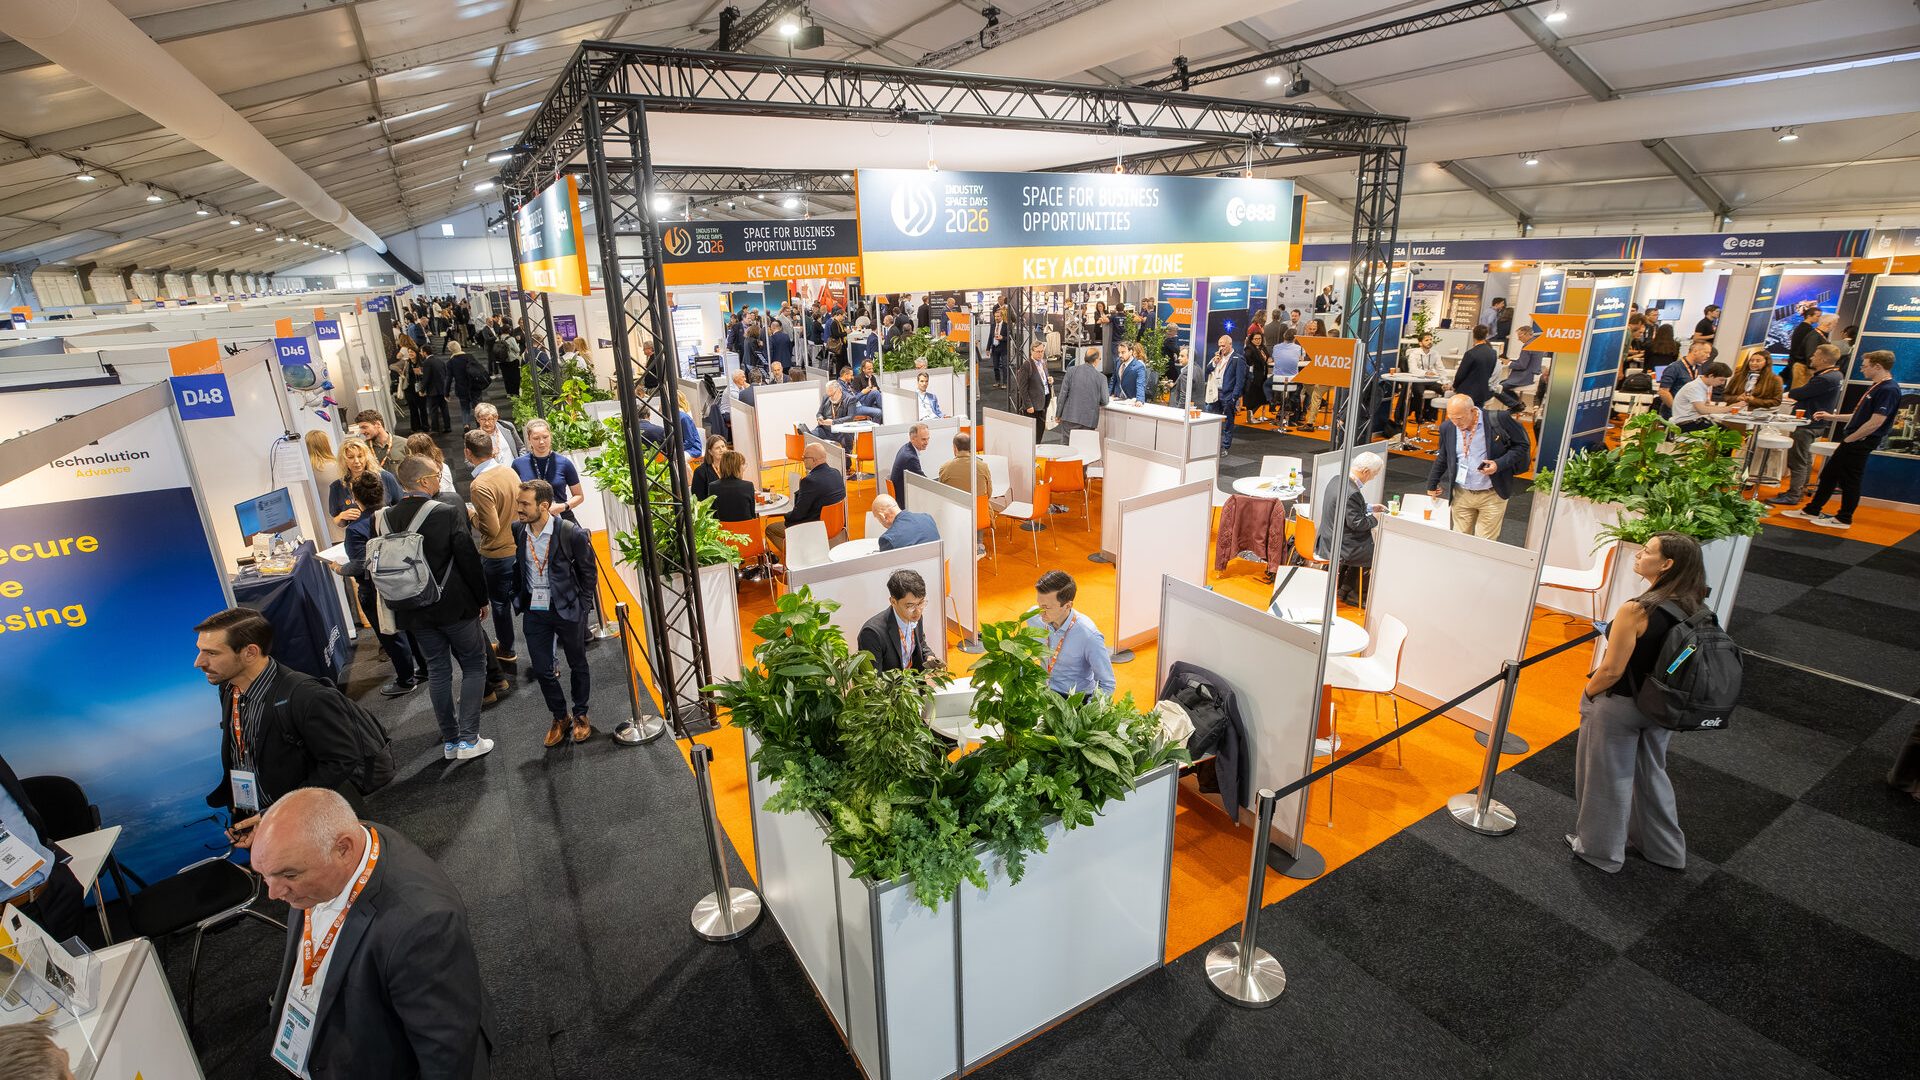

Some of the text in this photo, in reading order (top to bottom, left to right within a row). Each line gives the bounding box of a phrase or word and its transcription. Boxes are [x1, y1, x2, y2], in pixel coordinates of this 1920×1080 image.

[945, 184, 984, 195] INDUSTRY
[945, 196, 989, 207] SPACE DAYS
[1022, 186, 1160, 208] SPACE FOR BUSINESS
[945, 208, 989, 233] 2026
[1023, 212, 1131, 232] OPPORTUNITIES
[743, 225, 836, 240] SPACE FOR BUSINESS
[696, 240, 725, 254] 2026
[744, 239, 818, 253] OPPORTUNITIES
[1412, 247, 1446, 256] VILLAGE
[747, 262, 857, 279] KEY ACCOUNT ZONE
[1022, 252, 1184, 280] KEY ACCOUNT ZONE
[318, 325, 337, 335] D44
[1545, 327, 1582, 339] KAZ03
[281, 345, 306, 357] D46
[1314, 354, 1352, 370] KAZ02
[182, 387, 224, 407] D48
[75, 465, 131, 478] Advance
